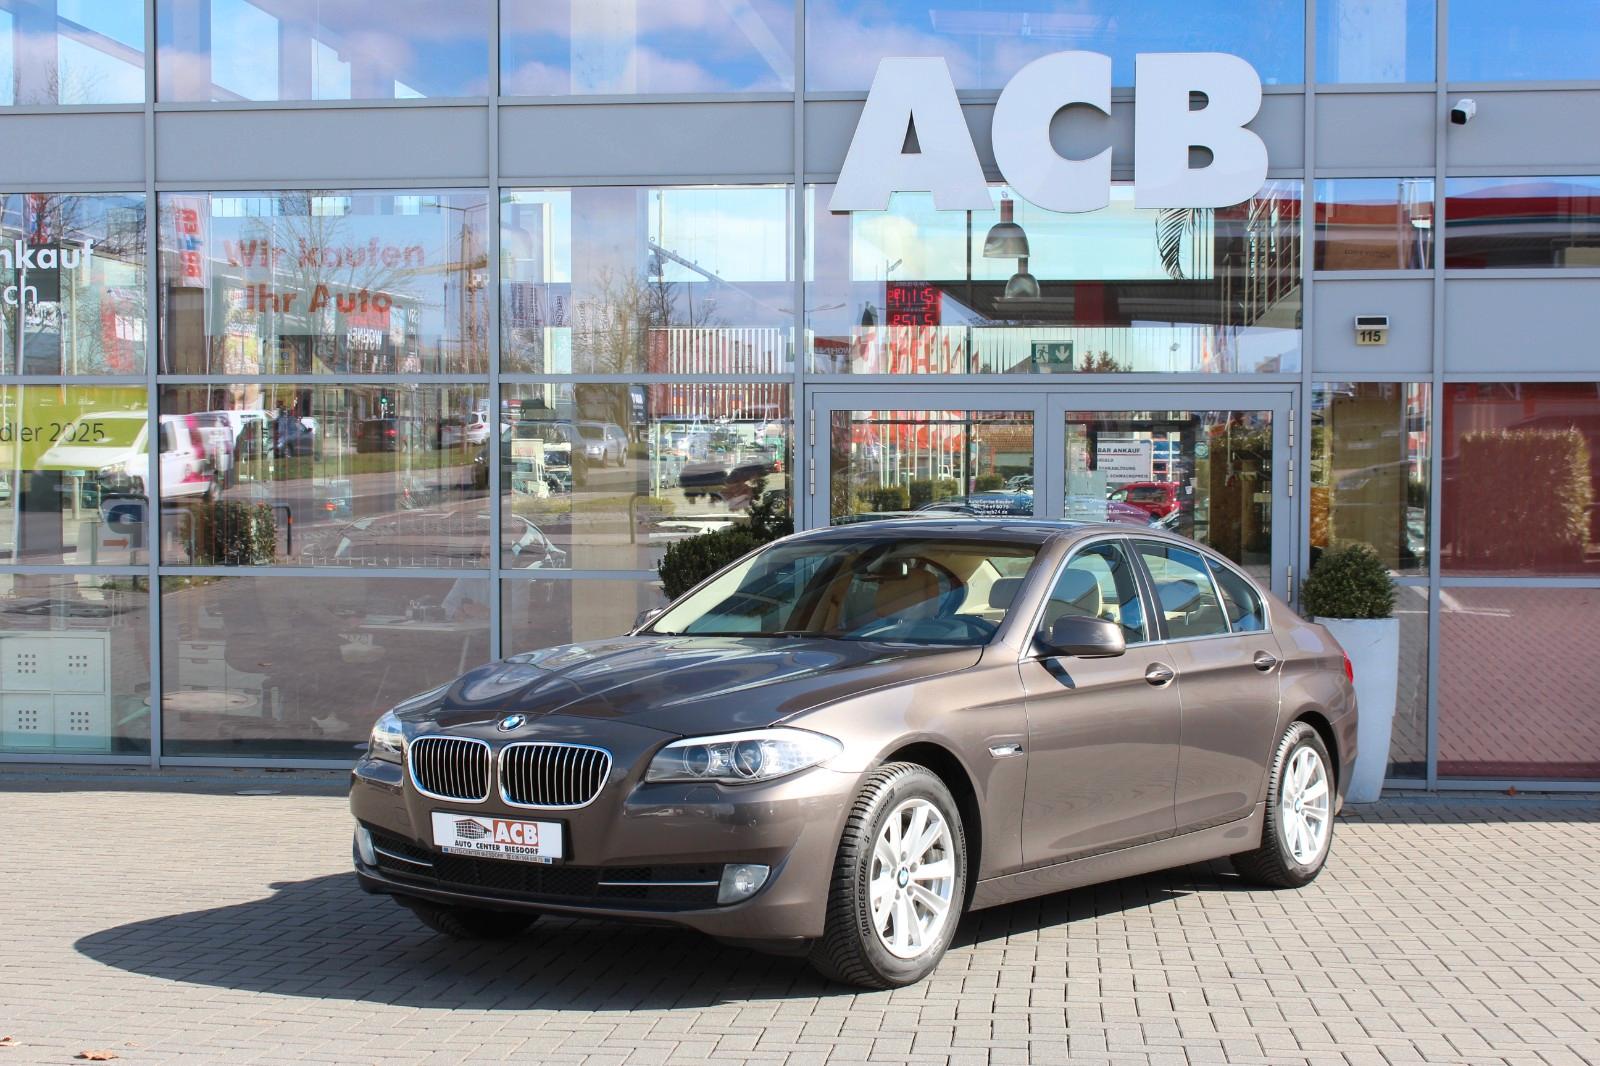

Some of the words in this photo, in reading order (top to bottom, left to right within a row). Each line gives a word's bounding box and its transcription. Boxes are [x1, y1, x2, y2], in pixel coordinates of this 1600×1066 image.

[829, 50, 1269, 213] ACB
[223, 238, 288, 268] Wir
[298, 236, 425, 268] kaufen
[246, 283, 297, 313] Ihr
[1359, 330, 1381, 343] 115
[49, 422, 105, 443] 2025
[495, 821, 539, 844] ACB
[454, 840, 472, 848] AUTO
[476, 842, 501, 851] CENTER
[504, 845, 539, 855] BIESDORF
[857, 857, 869, 938] BRIDGESTONE
